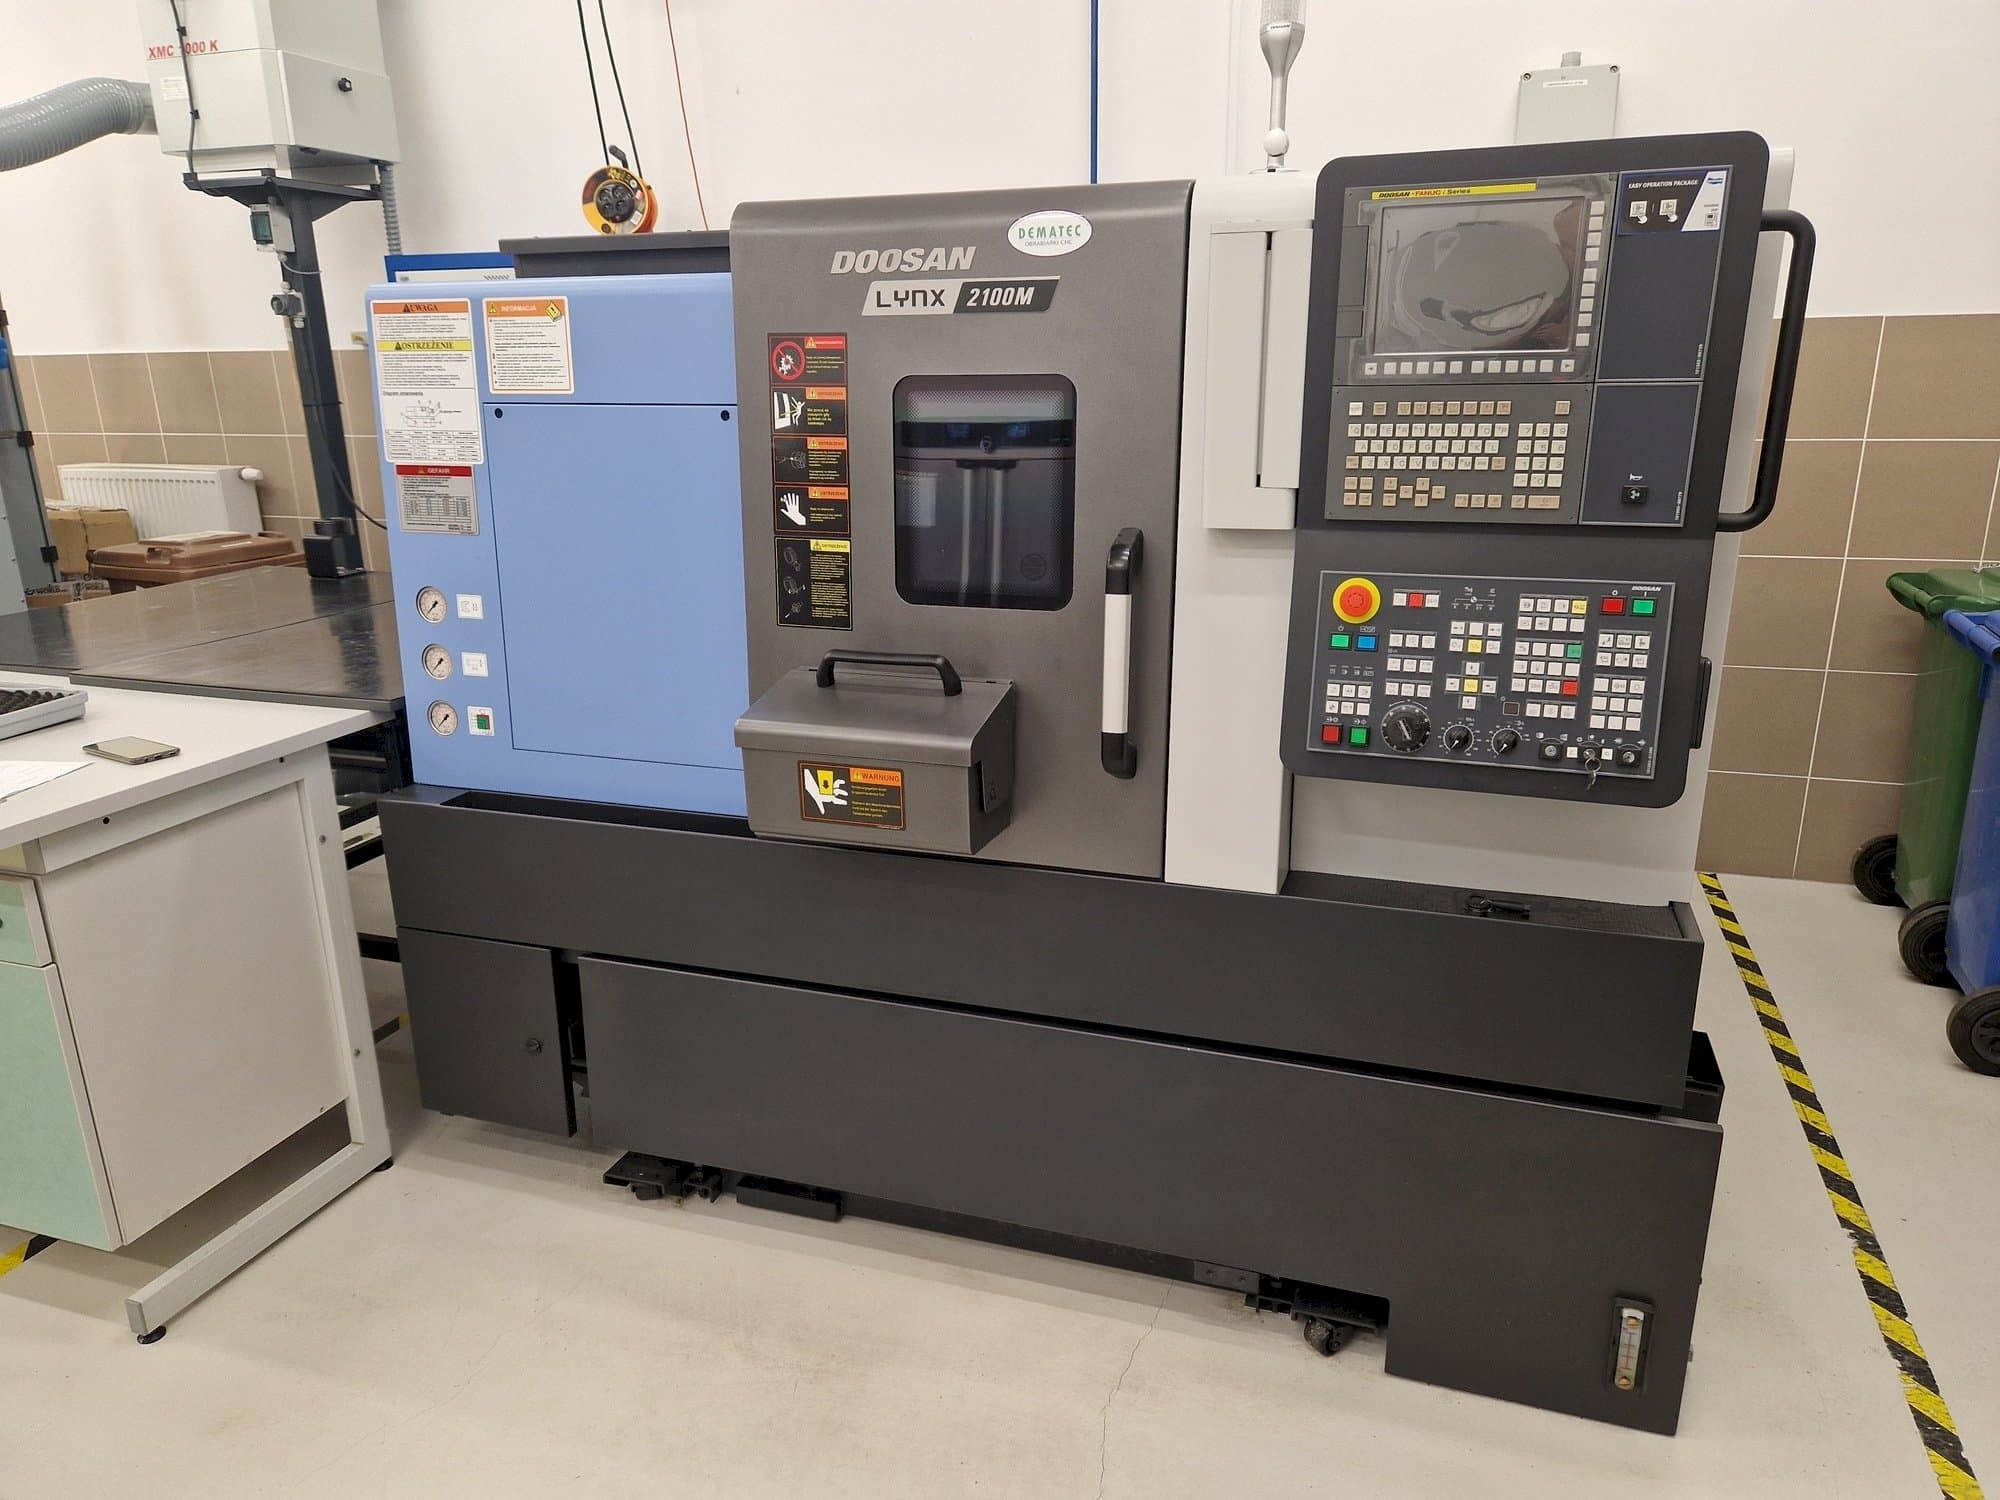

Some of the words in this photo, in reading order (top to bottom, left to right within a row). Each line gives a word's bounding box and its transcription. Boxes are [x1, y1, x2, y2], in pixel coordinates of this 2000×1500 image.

[148, 45, 174, 58] XMC
[180, 41, 206, 54] 000
[209, 40, 219, 51] K
[1642, 180, 1673, 189] OPERATION
[1673, 179, 1699, 187] PACKAGE
[1018, 224, 1081, 240] DEMATEC
[829, 246, 977, 275] DOOSAN
[876, 289, 945, 308] LYNX
[966, 286, 1035, 307] 2100M
[409, 303, 439, 313] UWAGA
[500, 304, 537, 312] INFORMACJA
[401, 340, 455, 350] OSTRZEŻENIE
[861, 772, 899, 782] WARNUNG
